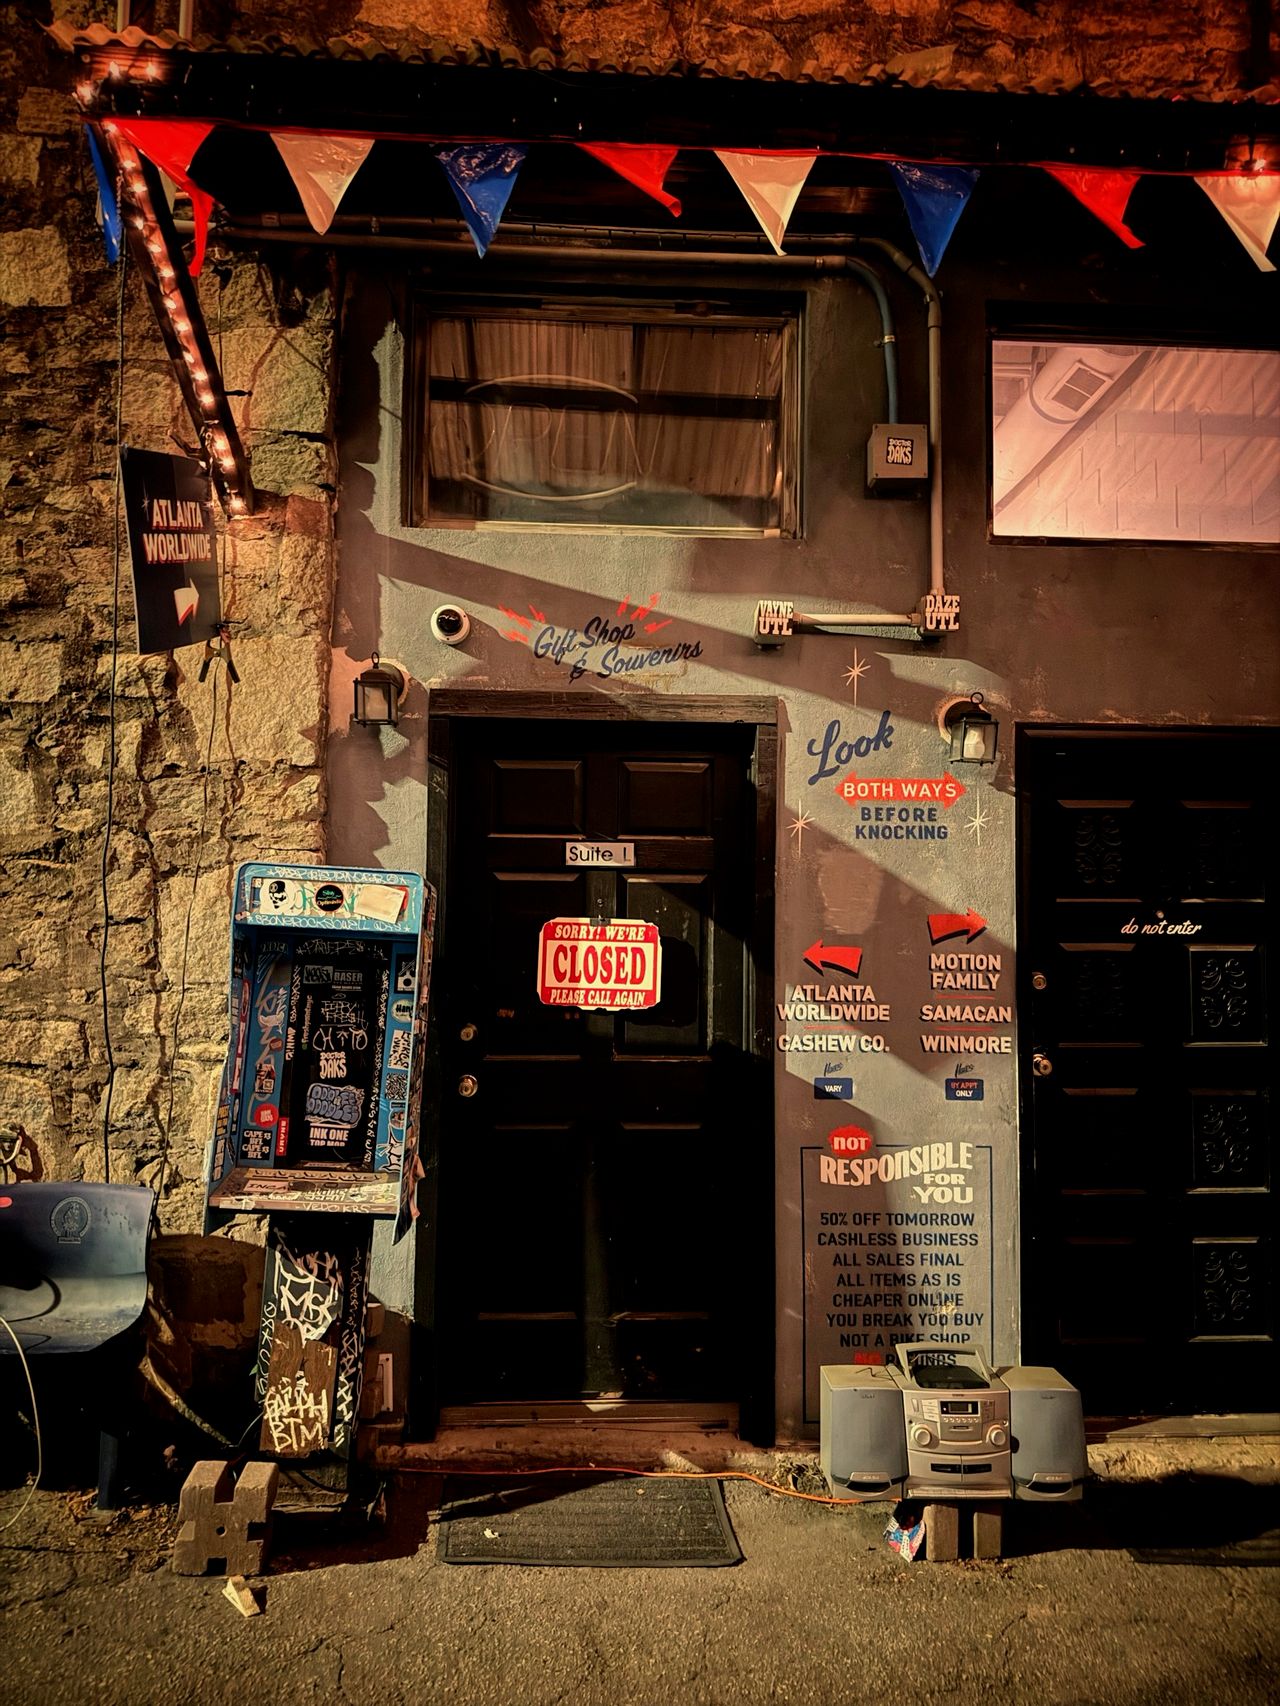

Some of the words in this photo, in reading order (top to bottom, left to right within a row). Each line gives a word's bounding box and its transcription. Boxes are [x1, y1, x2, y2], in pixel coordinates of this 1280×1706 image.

[887, 445, 912, 464] DAKS
[152, 498, 204, 529] ATLANTA
[143, 533, 211, 564] WORLDWIDE
[758, 600, 794, 619] VAYNE
[925, 595, 960, 613] DAZE
[758, 617, 793, 636] UTL
[925, 612, 960, 630] UTL
[533, 625, 578, 665] Gift
[579, 616, 636, 650] Shop
[569, 652, 588, 684] &
[596, 640, 704, 679] Souvenirs
[807, 711, 895, 785] Look
[843, 782, 895, 798] BOTH
[902, 781, 957, 798] WAYS
[860, 806, 938, 822] BEFORE
[854, 824, 948, 840] KNOCKING
[569, 846, 614, 862] Suite
[555, 925, 601, 940] SORRY!
[605, 926, 646, 941] WE'RE
[1121, 918, 1139, 934] do
[1141, 920, 1166, 934] not
[1166, 920, 1202, 934] enter
[552, 944, 647, 985] CLOSED
[929, 953, 1001, 972] MOTION
[931, 972, 1000, 991] FAMILY
[549, 989, 585, 1004] PLEASE
[587, 991, 612, 1005] CALL
[613, 991, 646, 1006] AGAIN
[791, 984, 876, 1003] ATLANTA
[777, 1004, 890, 1023] WORLDWIDE
[920, 1005, 1012, 1024] SAMACAN
[777, 1034, 856, 1053] CASHEW
[862, 1035, 891, 1053] CO.
[921, 1034, 1012, 1053] WINMORE
[320, 1051, 347, 1060] DOCTOR
[320, 1059, 347, 1079] DAKS
[824, 1085, 843, 1093] VARY
[955, 1089, 974, 1098] ONLY
[309, 1127, 327, 1140] INK
[329, 1129, 349, 1141] ONE
[833, 1136, 869, 1151] NOT
[819, 1141, 973, 1187] RESPONSIBLE
[923, 1173, 966, 1185] FOR
[912, 1186, 974, 1204] YOU
[820, 1213, 848, 1226] 50%
[852, 1213, 881, 1226] OFF
[885, 1213, 975, 1226] TOMORROW
[817, 1232, 897, 1246] CASHLESS
[903, 1232, 979, 1246] BUSINESS
[832, 1253, 861, 1267] ALL
[866, 1253, 915, 1267] SALES
[920, 1253, 964, 1267] FINAL
[836, 1273, 864, 1287] ALL
[870, 1273, 916, 1287] ITEMS
[920, 1273, 941, 1287] AS
[946, 1273, 961, 1287] IS
[832, 1294, 903, 1307] CHEAPER
[907, 1294, 964, 1307] ONLINE
[826, 1313, 857, 1327] YOU
[863, 1313, 914, 1327] BREAK
[918, 1313, 948, 1327] YOU
[953, 1313, 984, 1327] BUY
[839, 1334, 870, 1347] NOT
[874, 1334, 885, 1347] A
[889, 1334, 924, 1347] BIKE
[930, 1334, 970, 1344] SHOP
